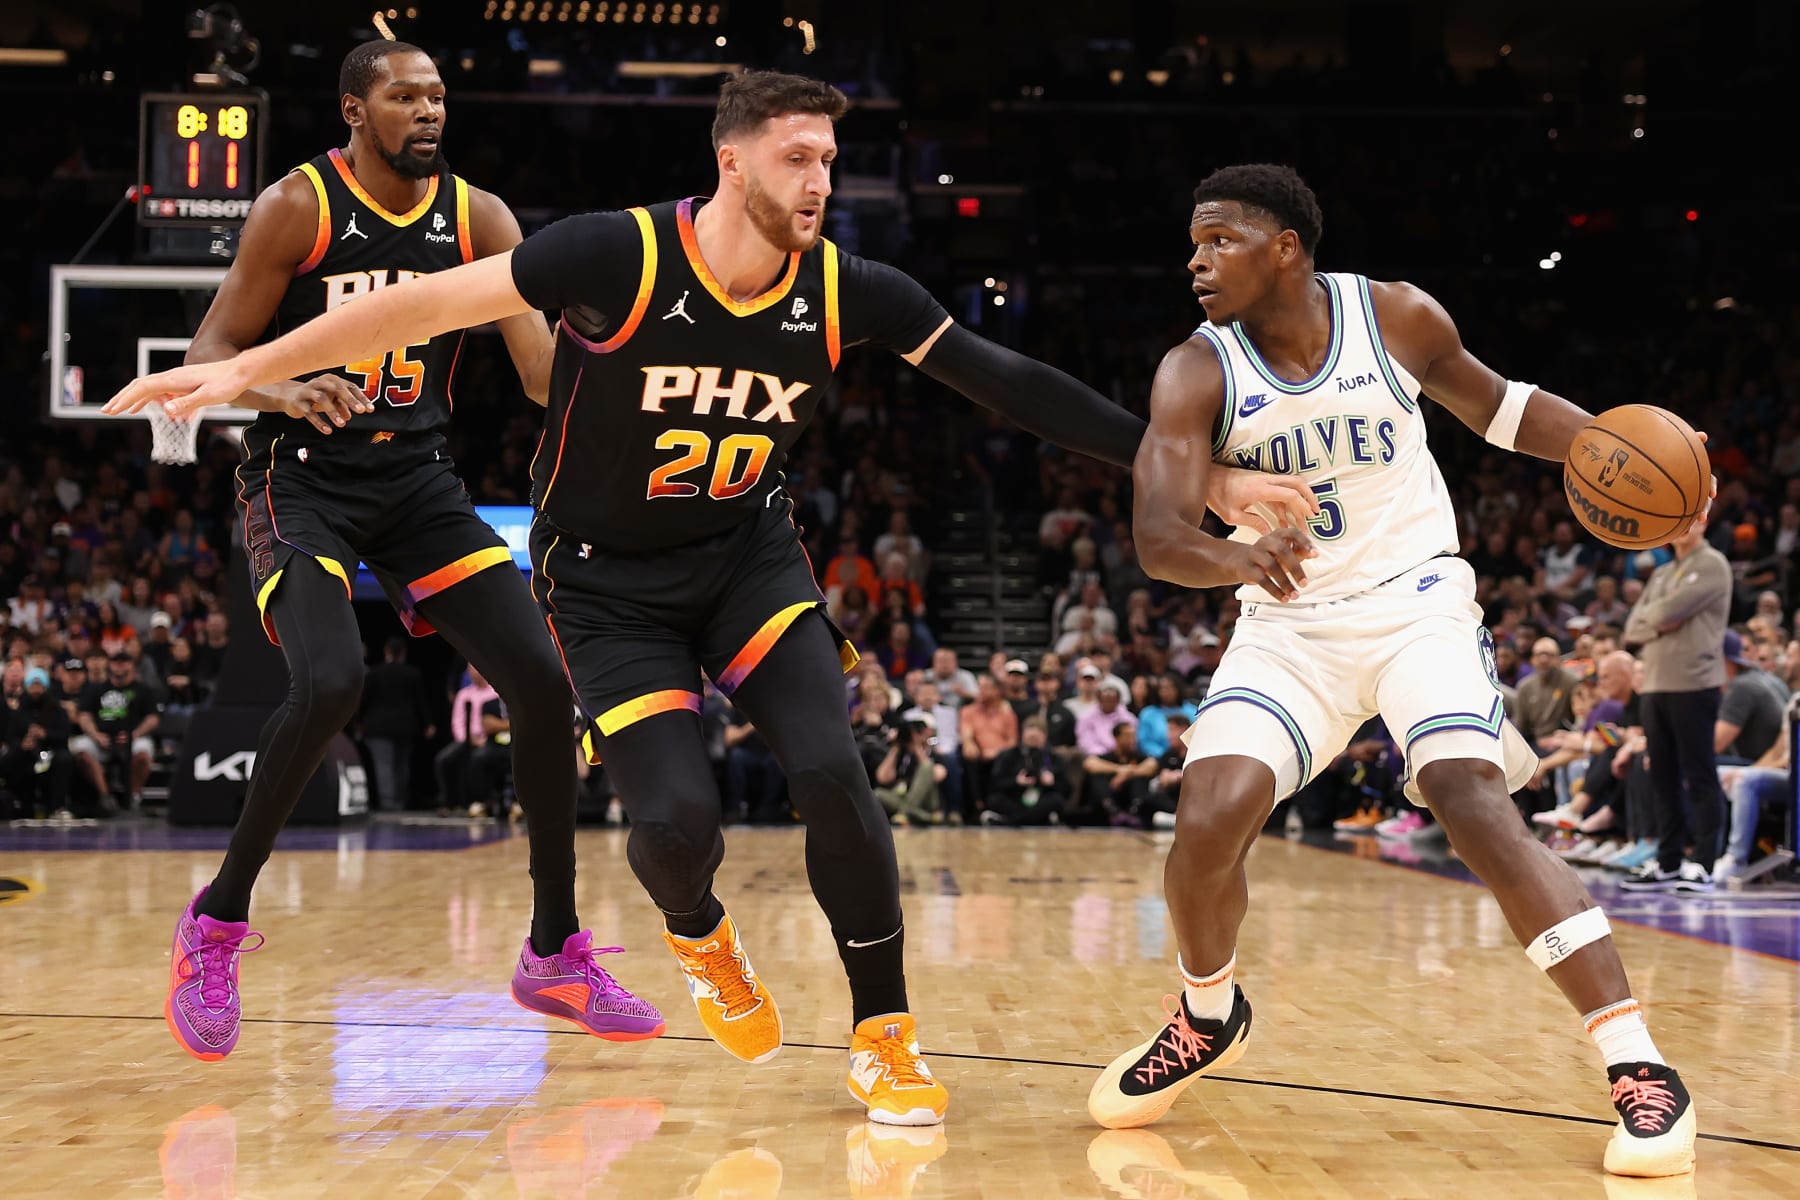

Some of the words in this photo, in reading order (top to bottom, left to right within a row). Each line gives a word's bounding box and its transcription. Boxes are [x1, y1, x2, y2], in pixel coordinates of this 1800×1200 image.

[425, 232, 454, 243] PayPal
[781, 322, 817, 332] PayPal
[640, 366, 812, 423] PHX
[1244, 393, 1267, 408] NIKE
[1232, 415, 1397, 476] WOLVES
[647, 429, 774, 500] 20
[1306, 477, 1347, 541] 5
[1419, 573, 1441, 586] NIKE
[1544, 930, 1561, 949] 5
